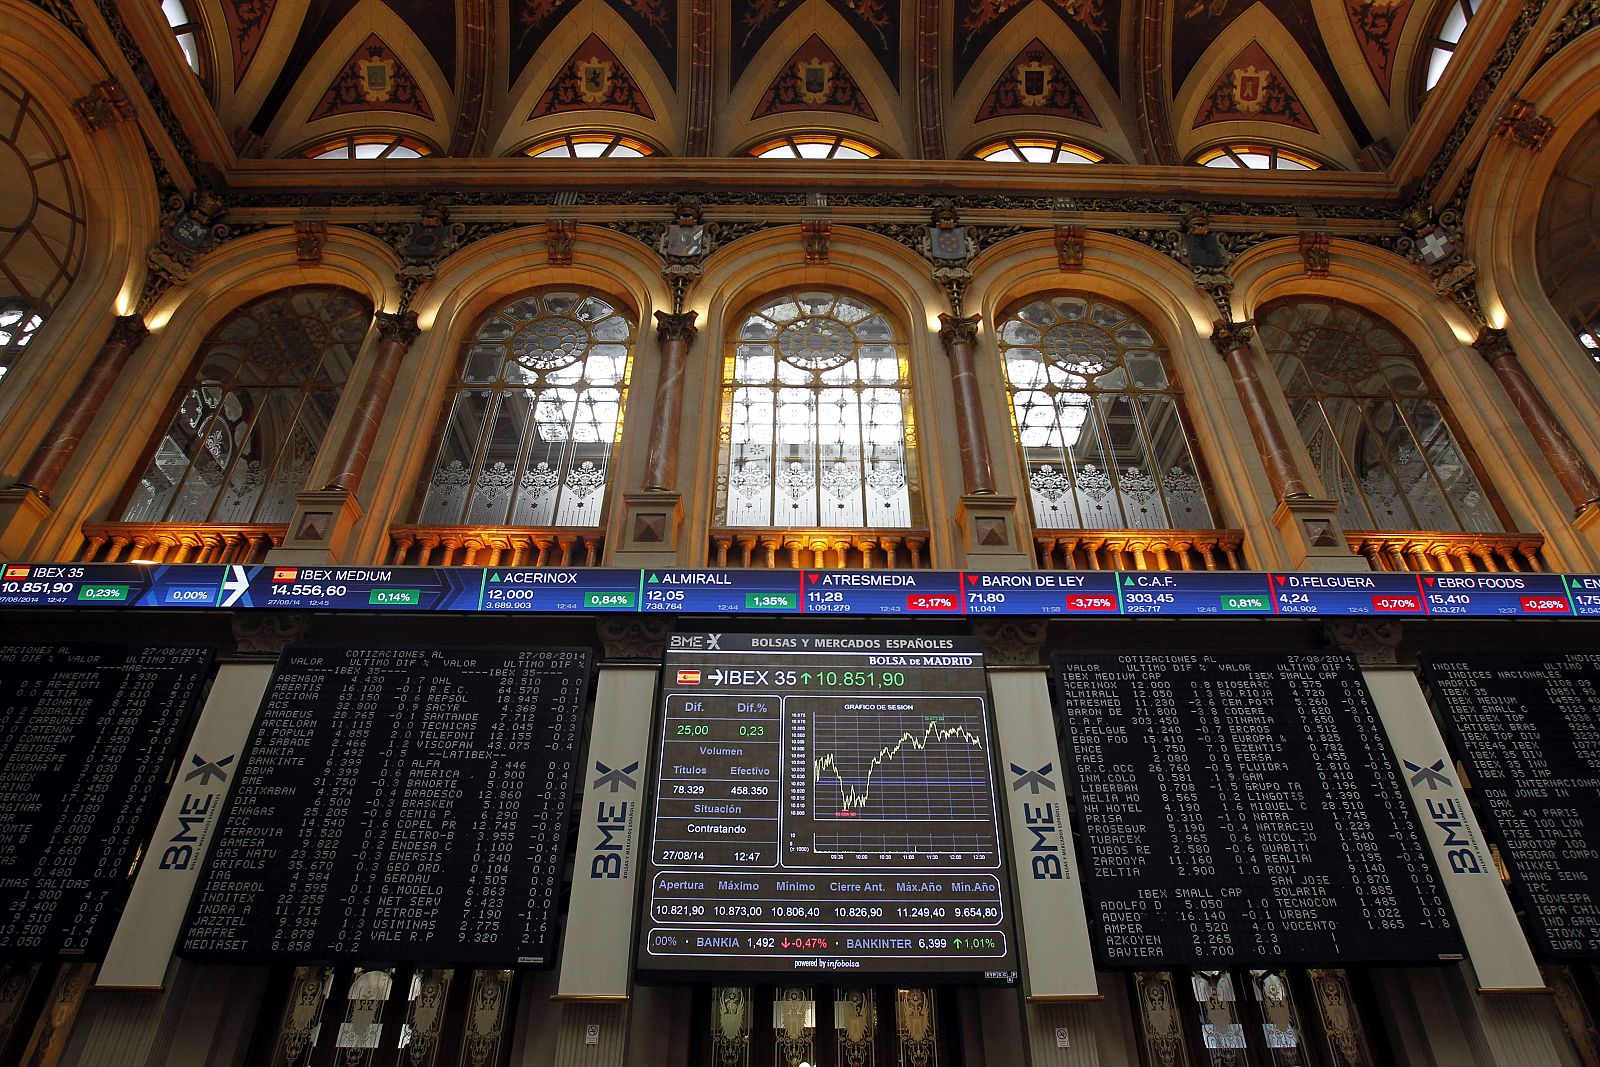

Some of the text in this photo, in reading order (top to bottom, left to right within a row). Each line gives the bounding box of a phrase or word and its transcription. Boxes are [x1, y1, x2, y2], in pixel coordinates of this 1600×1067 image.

[33, 567, 84, 578] IBEX 35
[300, 570, 392, 582] IBEX MEDIUM
[503, 572, 577, 584] ACERINOX
[662, 574, 732, 585] ALMIRALL
[822, 575, 916, 587] ATRESMEDIA
[982, 576, 1085, 587] BARON DE LEY
[1137, 576, 1177, 587] C.A.F.
[1289, 576, 1375, 588] D.FELGUERA
[1438, 577, 1525, 589] EBRO FOODS
[1, 582, 121, 599] 10.851,90 0,23%
[173, 590, 208, 601] 0,00%
[271, 585, 411, 603] 14.556,60 0,14%
[487, 589, 628, 606] 12,000 0,84%
[646, 590, 788, 607] 12,05 1,35%
[808, 592, 952, 608] 11,28 -2,17%
[968, 593, 1111, 609] 71,80 -3,75%
[1126, 593, 1262, 608] 303,45 0,81%
[1279, 593, 1415, 609] 4,24 -0,70%
[1428, 594, 1564, 610] 15,410 -0,26%
[485, 602, 532, 610] 3.689.903
[808, 604, 850, 612] 1.091.279
[970, 605, 996, 613] 11.041
[1127, 605, 1161, 613] 225.717
[1432, 606, 1467, 614] 433.274
[671, 635, 703, 648] BME
[751, 637, 953, 649] BOLSAS Y MERCADOS ESPAÑOLES
[142, 648, 207, 656] 27/08/2014
[345, 650, 586, 660] COTIZACIONES AL 27/08/2014
[869, 656, 907, 666] BOLSA
[923, 656, 973, 666] MADRID
[1118, 655, 1197, 664] COTIZACIONES
[1287, 655, 1351, 663] 27/08/2014
[724, 670, 905, 688] IBEX 35 10.851,90
[1447, 671, 1561, 679] INDICES NACIONALES
[274, 684, 322, 693] ABERTIS
[271, 692, 319, 701] ACCIONA
[685, 702, 768, 713] Dif. Dif.%
[1224, 707, 1265, 715] CODERE
[28, 717, 84, 725] CARBURES
[423, 713, 479, 722] SANTANDE
[420, 731, 474, 740] TELEFONI
[676, 725, 764, 737] 25,00 0,23
[700, 747, 743, 756] Volumen
[1236, 753, 1272, 762] FERSA
[673, 765, 770, 776] Títulos Efectivo
[673, 785, 769, 795] 78.329 458.350
[694, 804, 742, 814] Situación
[159, 794, 213, 870] BME
[687, 824, 747, 834] Contratando
[591, 802, 627, 878] BME
[1024, 803, 1062, 879] BME
[1426, 799, 1481, 873] BME
[662, 851, 761, 861] 27/08/14 12:47
[212, 860, 266, 870] GRIFOLS
[1267, 865, 1297, 874] ROVI
[1517, 861, 1561, 870] NIKKEI
[35, 879, 90, 889] SALIDAS
[658, 880, 996, 893] Apertura Máximo Mínimo Cierre Ant. Máx.Año Mín.Año
[201, 893, 255, 904] INDITEX
[1531, 894, 1592, 904] IBOVESPA
[656, 905, 998, 919] 10.821,90 10.873,00 10.806,40 10.826,90 11.249,40 9.654,80
[188, 928, 237, 938] MAPFRE
[1104, 922, 1143, 933] AMPER
[183, 940, 249, 950] MEDIASET
[696, 937, 740, 948] BANKIA
[747, 937, 775, 949] 1,492
[791, 938, 828, 949] -0,47%
[846, 938, 912, 949] BANKINTER
[918, 938, 947, 950] 6,399
[964, 938, 995, 949] 1,01%
[1106, 935, 1162, 945] AZKOYEN
[794, 959, 860, 969] powered by infobolsa
